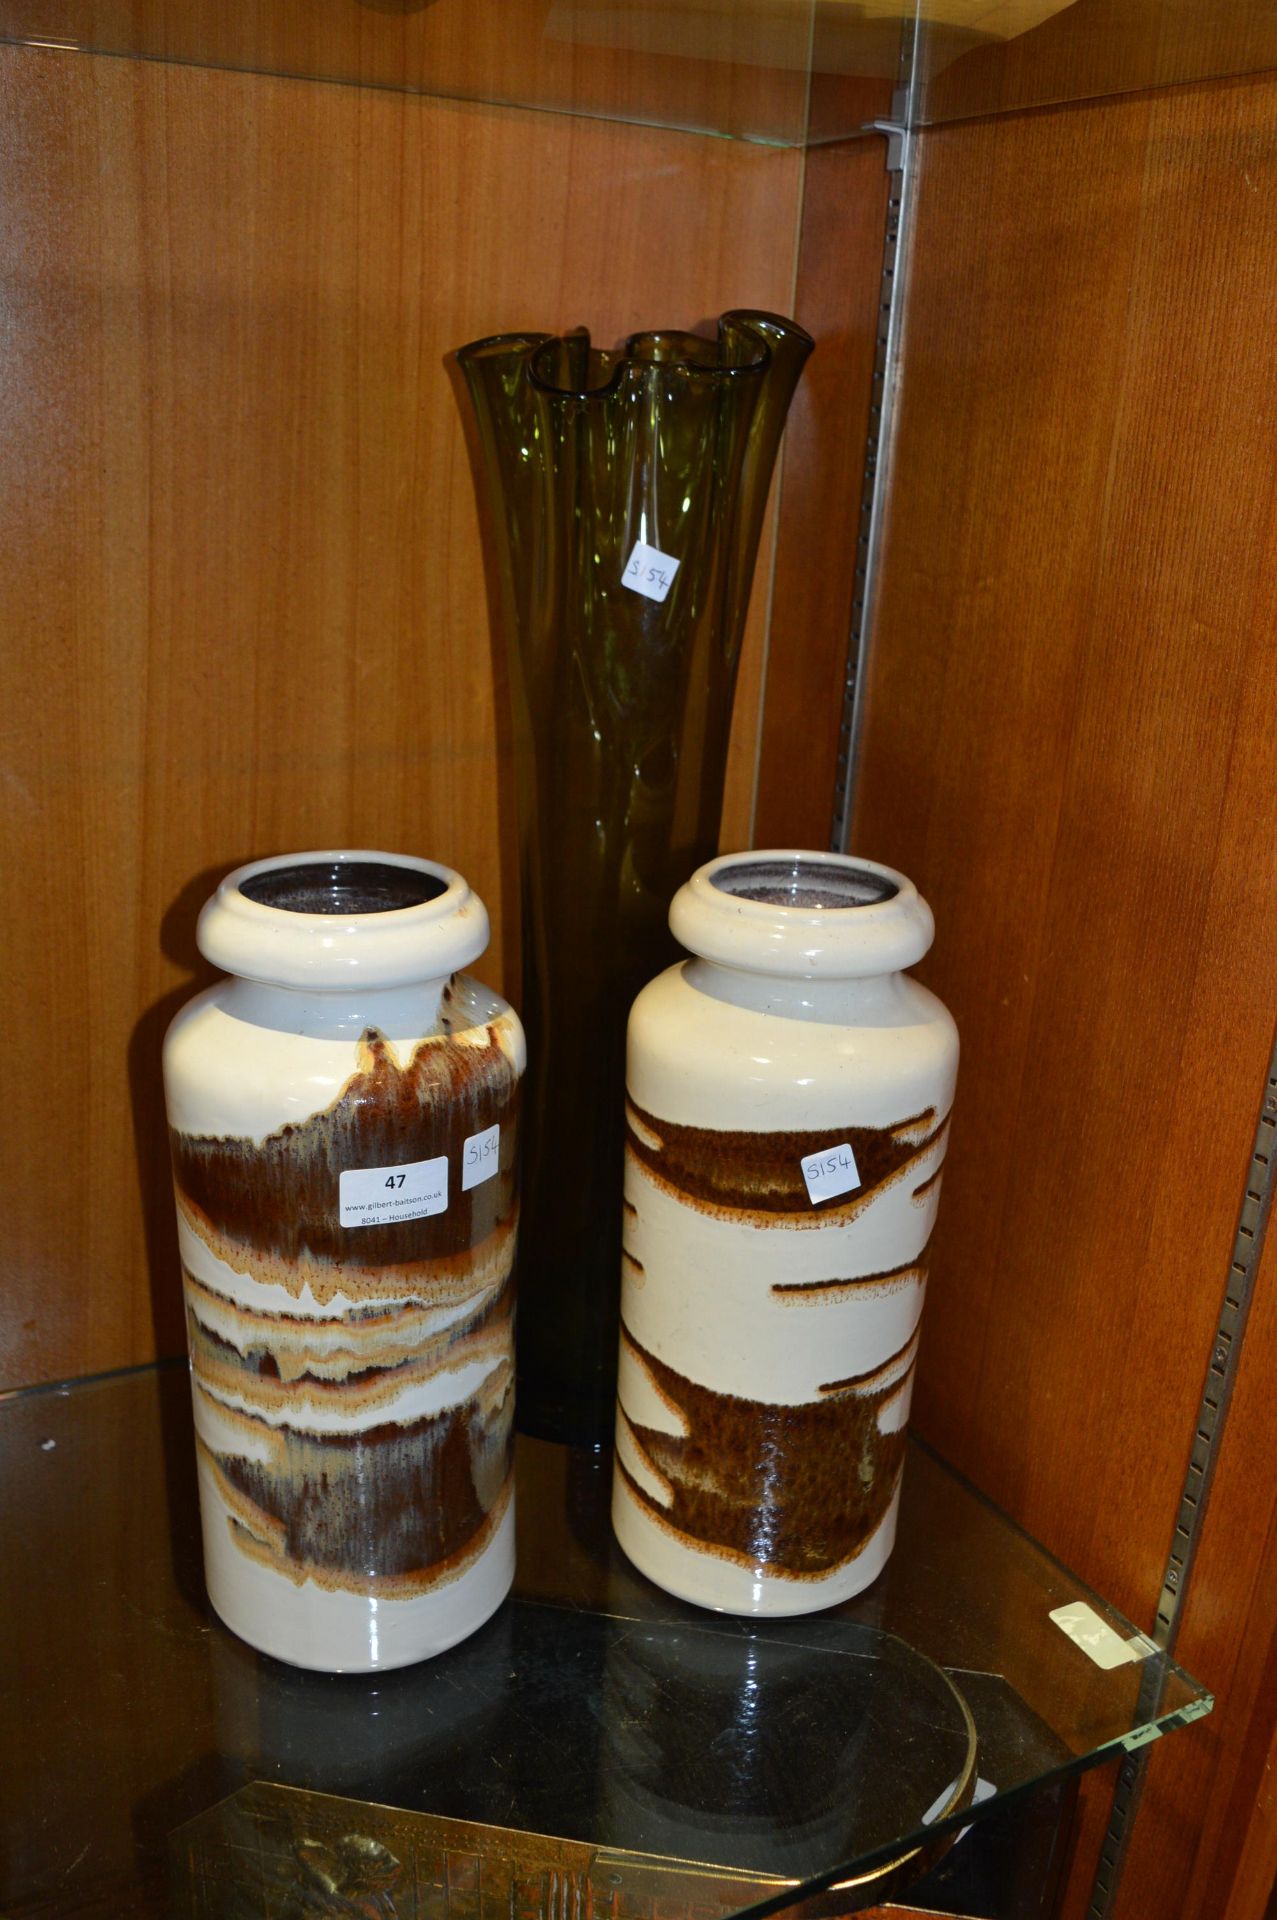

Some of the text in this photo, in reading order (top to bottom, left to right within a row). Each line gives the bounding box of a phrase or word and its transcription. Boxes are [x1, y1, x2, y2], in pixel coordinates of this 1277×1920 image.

[384, 1174, 406, 1189] 47
[344, 1190, 442, 1212] www.gilbert-baitson.co.uk
[361, 1216, 380, 1225] 8041
[389, 1208, 428, 1222] Household
